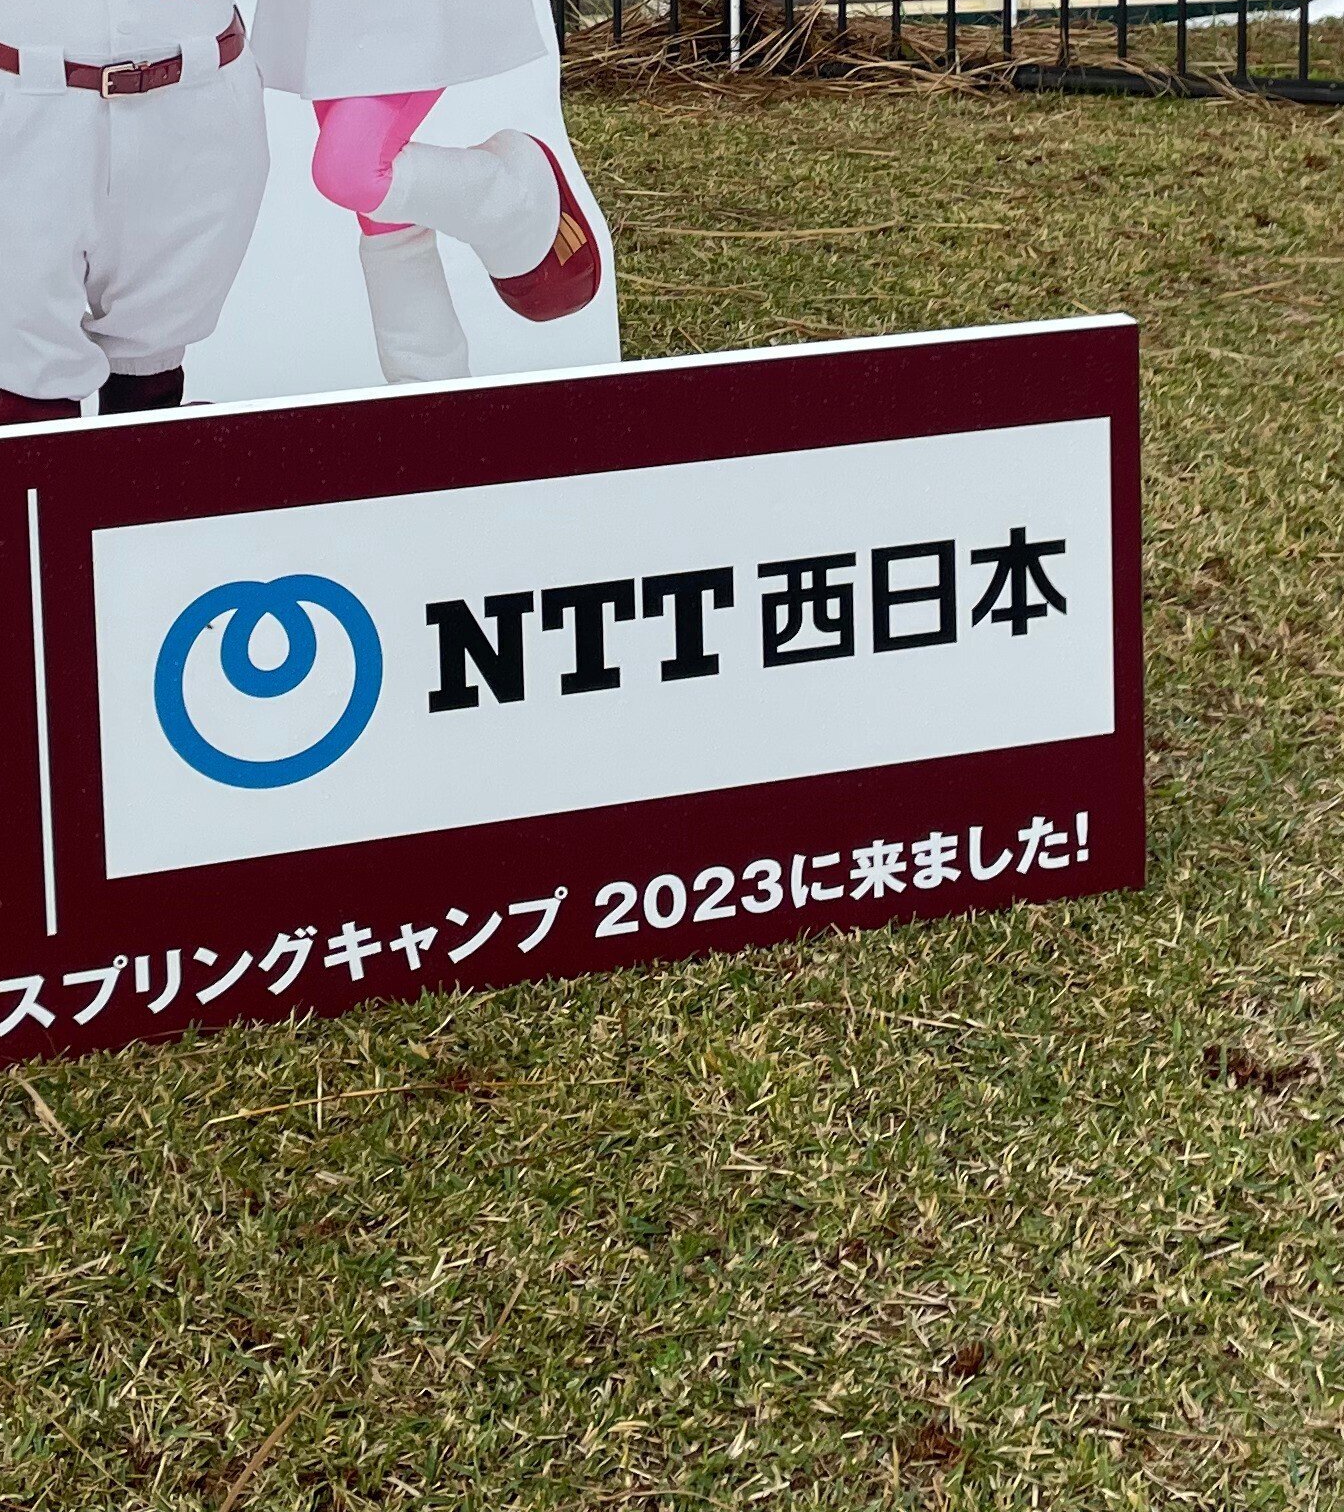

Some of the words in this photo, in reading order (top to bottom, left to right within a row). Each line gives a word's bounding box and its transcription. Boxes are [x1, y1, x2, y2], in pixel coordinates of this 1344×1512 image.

[593, 811, 1090, 939] 2023に来ました!
